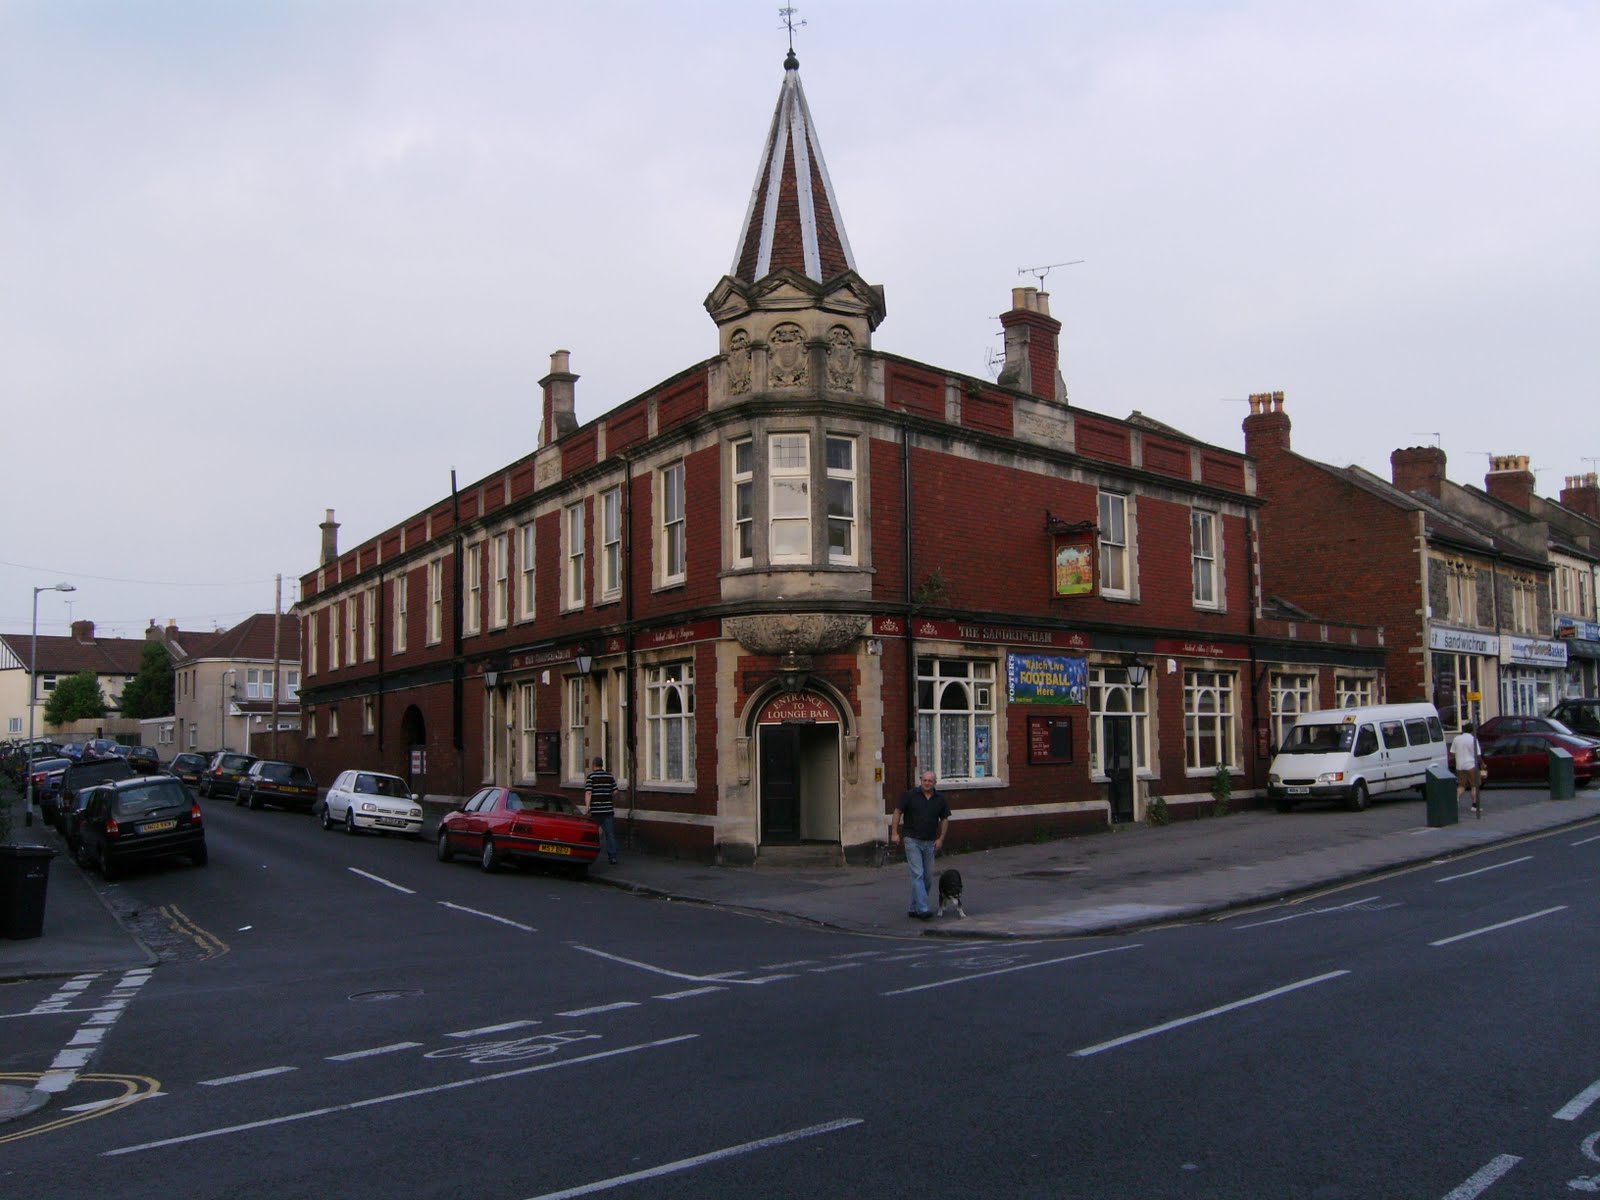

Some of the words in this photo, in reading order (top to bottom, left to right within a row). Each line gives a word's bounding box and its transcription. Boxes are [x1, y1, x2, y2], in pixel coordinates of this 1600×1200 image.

[959, 626, 979, 638] THE
[982, 627, 1052, 642] SANDRINGHAM
[1445, 634, 1487, 651] sandwichrun
[1024, 660, 1047, 670] Watch
[1050, 662, 1064, 671] Live
[1020, 672, 1070, 686] FOOTBALL
[1037, 687, 1054, 696] Here
[773, 693, 824, 709] ENTRANCE
[793, 702, 804, 710] TO
[768, 710, 807, 719] LOUNGE
[810, 710, 829, 718] BAR
